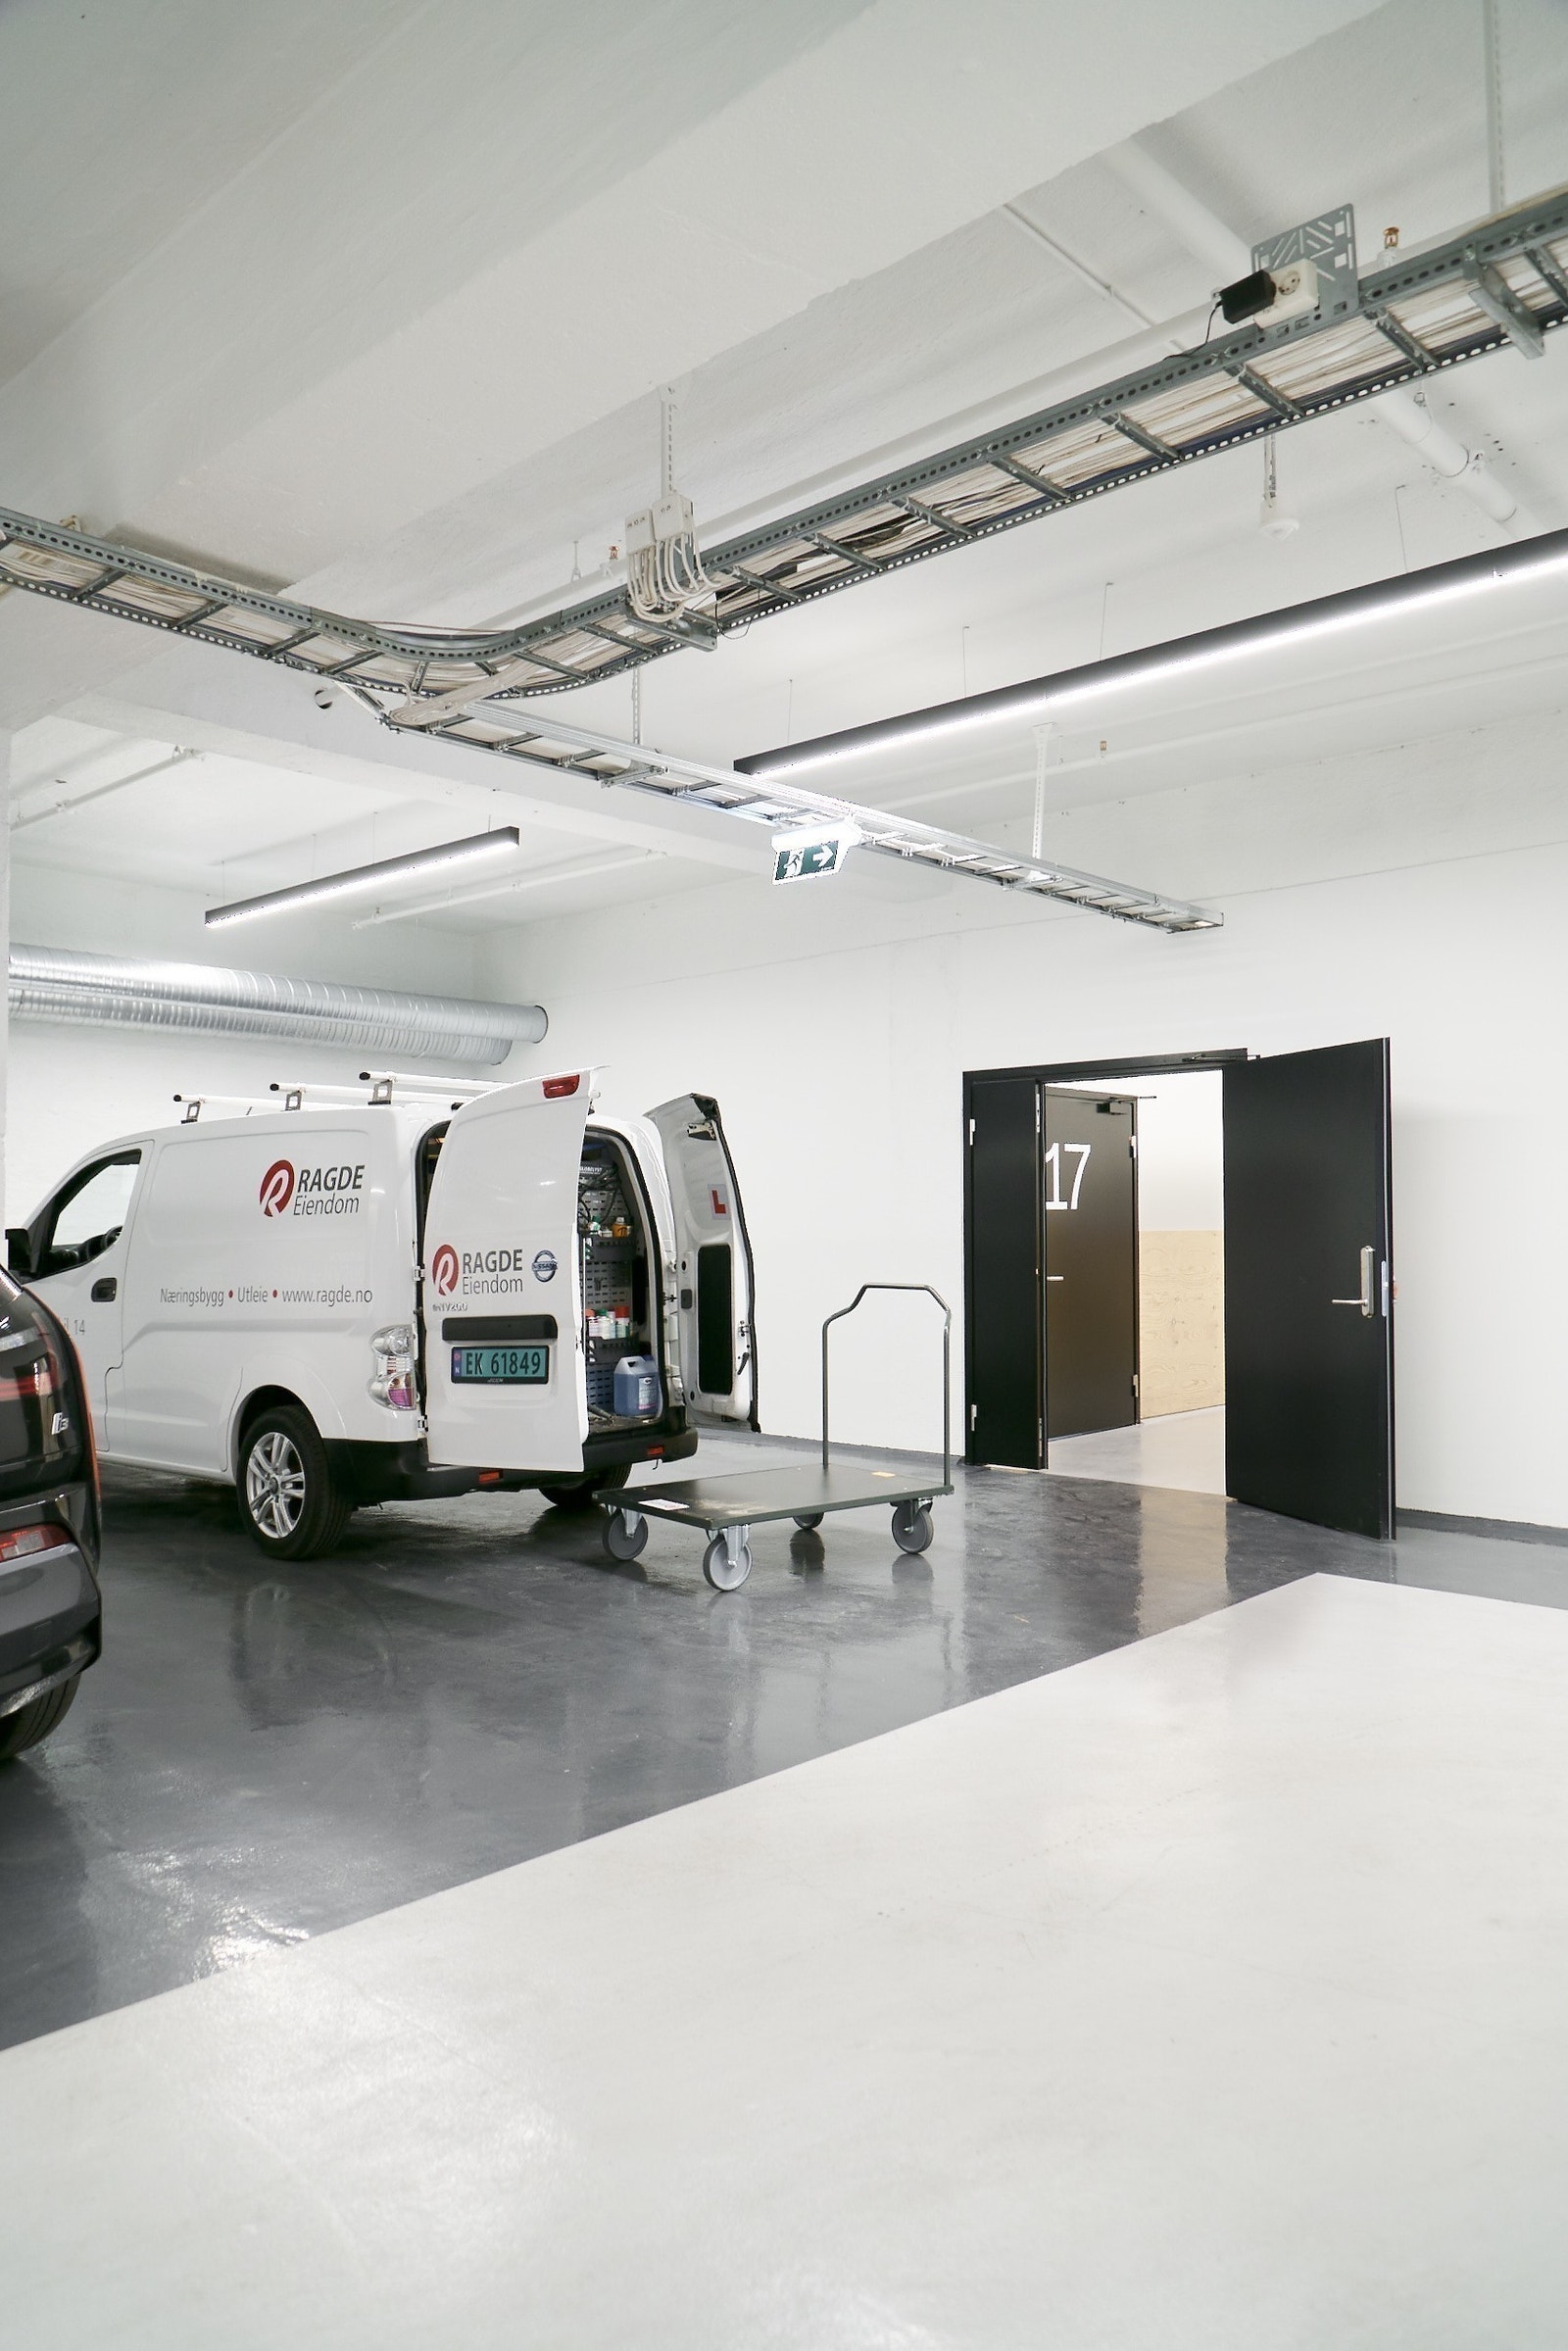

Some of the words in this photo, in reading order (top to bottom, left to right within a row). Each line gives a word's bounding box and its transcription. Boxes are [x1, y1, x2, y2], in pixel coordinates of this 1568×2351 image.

[297, 1164, 365, 1193] RAGDE
[1046, 1143, 1091, 1209] 17
[294, 1193, 360, 1215] Eiendom
[711, 1190, 726, 1213] L
[463, 1249, 522, 1274] RAGDE
[160, 1288, 224, 1307] Næringsbygg
[237, 1286, 269, 1302] Utleie
[282, 1285, 373, 1307] www.ragde.no
[462, 1274, 523, 1295] Eiendom
[74, 1319, 85, 1335] 14
[466, 1352, 483, 1375] EK
[491, 1351, 541, 1375] 61849
